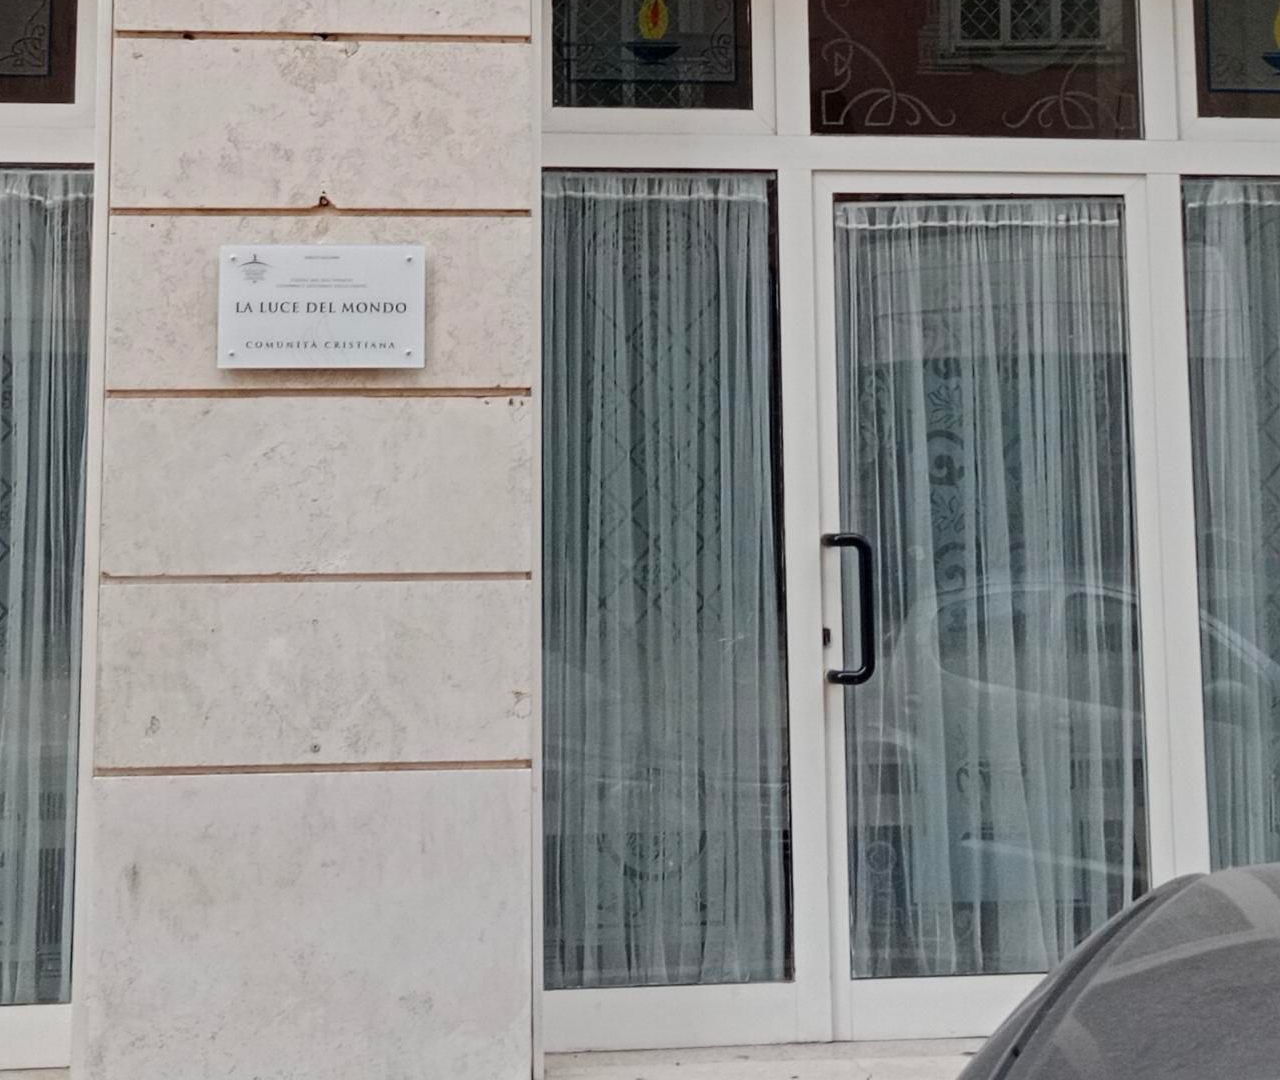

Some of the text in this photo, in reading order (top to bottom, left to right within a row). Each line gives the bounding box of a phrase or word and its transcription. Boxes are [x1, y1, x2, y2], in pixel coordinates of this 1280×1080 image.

[235, 301, 408, 314] LA LUCE DEL MONDO
[324, 340, 396, 349] CRISTIANA
